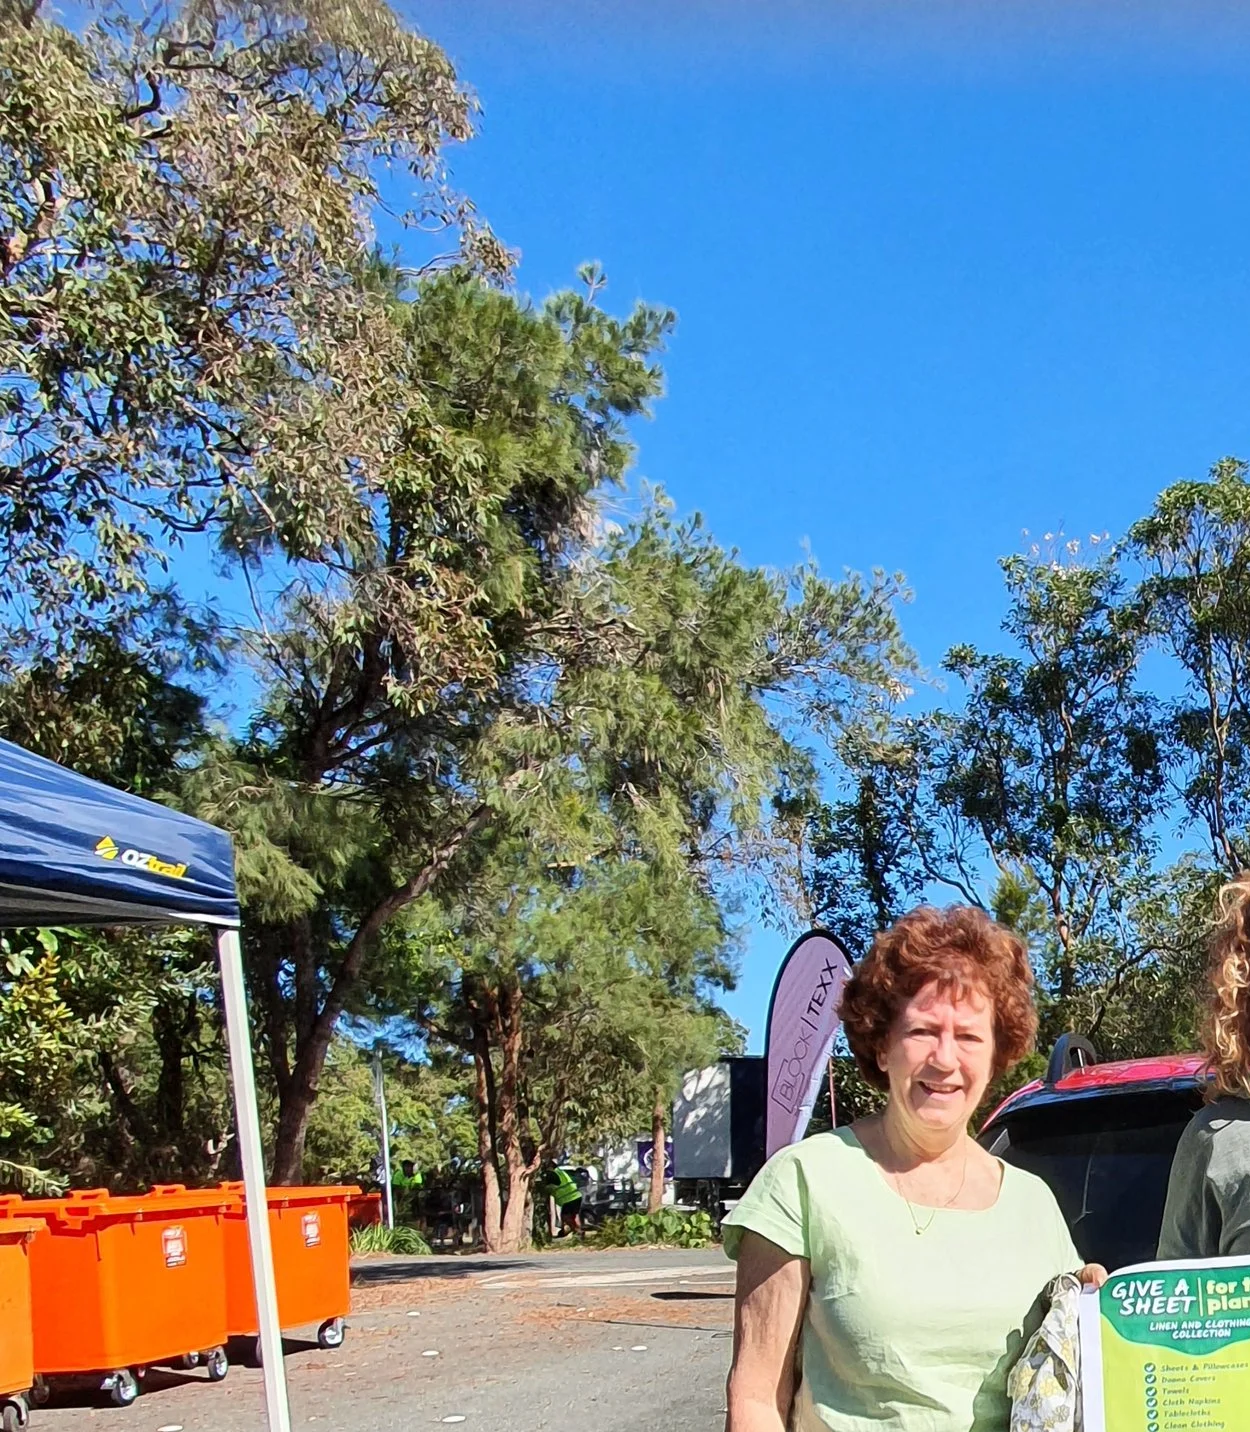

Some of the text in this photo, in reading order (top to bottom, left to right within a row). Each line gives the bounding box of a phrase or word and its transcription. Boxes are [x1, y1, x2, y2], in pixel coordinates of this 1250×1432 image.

[121, 849, 187, 877] OZtrail
[779, 958, 838, 1102] BLOCK TEXX
[1112, 1278, 1190, 1299] GIVE A
[1206, 1280, 1238, 1295] for
[1119, 1296, 1196, 1316] SHEET
[1150, 1321, 1178, 1331] LINEN
[1181, 1320, 1201, 1330] AND
[1172, 1329, 1231, 1339] COLLECTION
[1203, 1362, 1249, 1370] Pillowcases
[1191, 1420, 1225, 1429] Clothing
